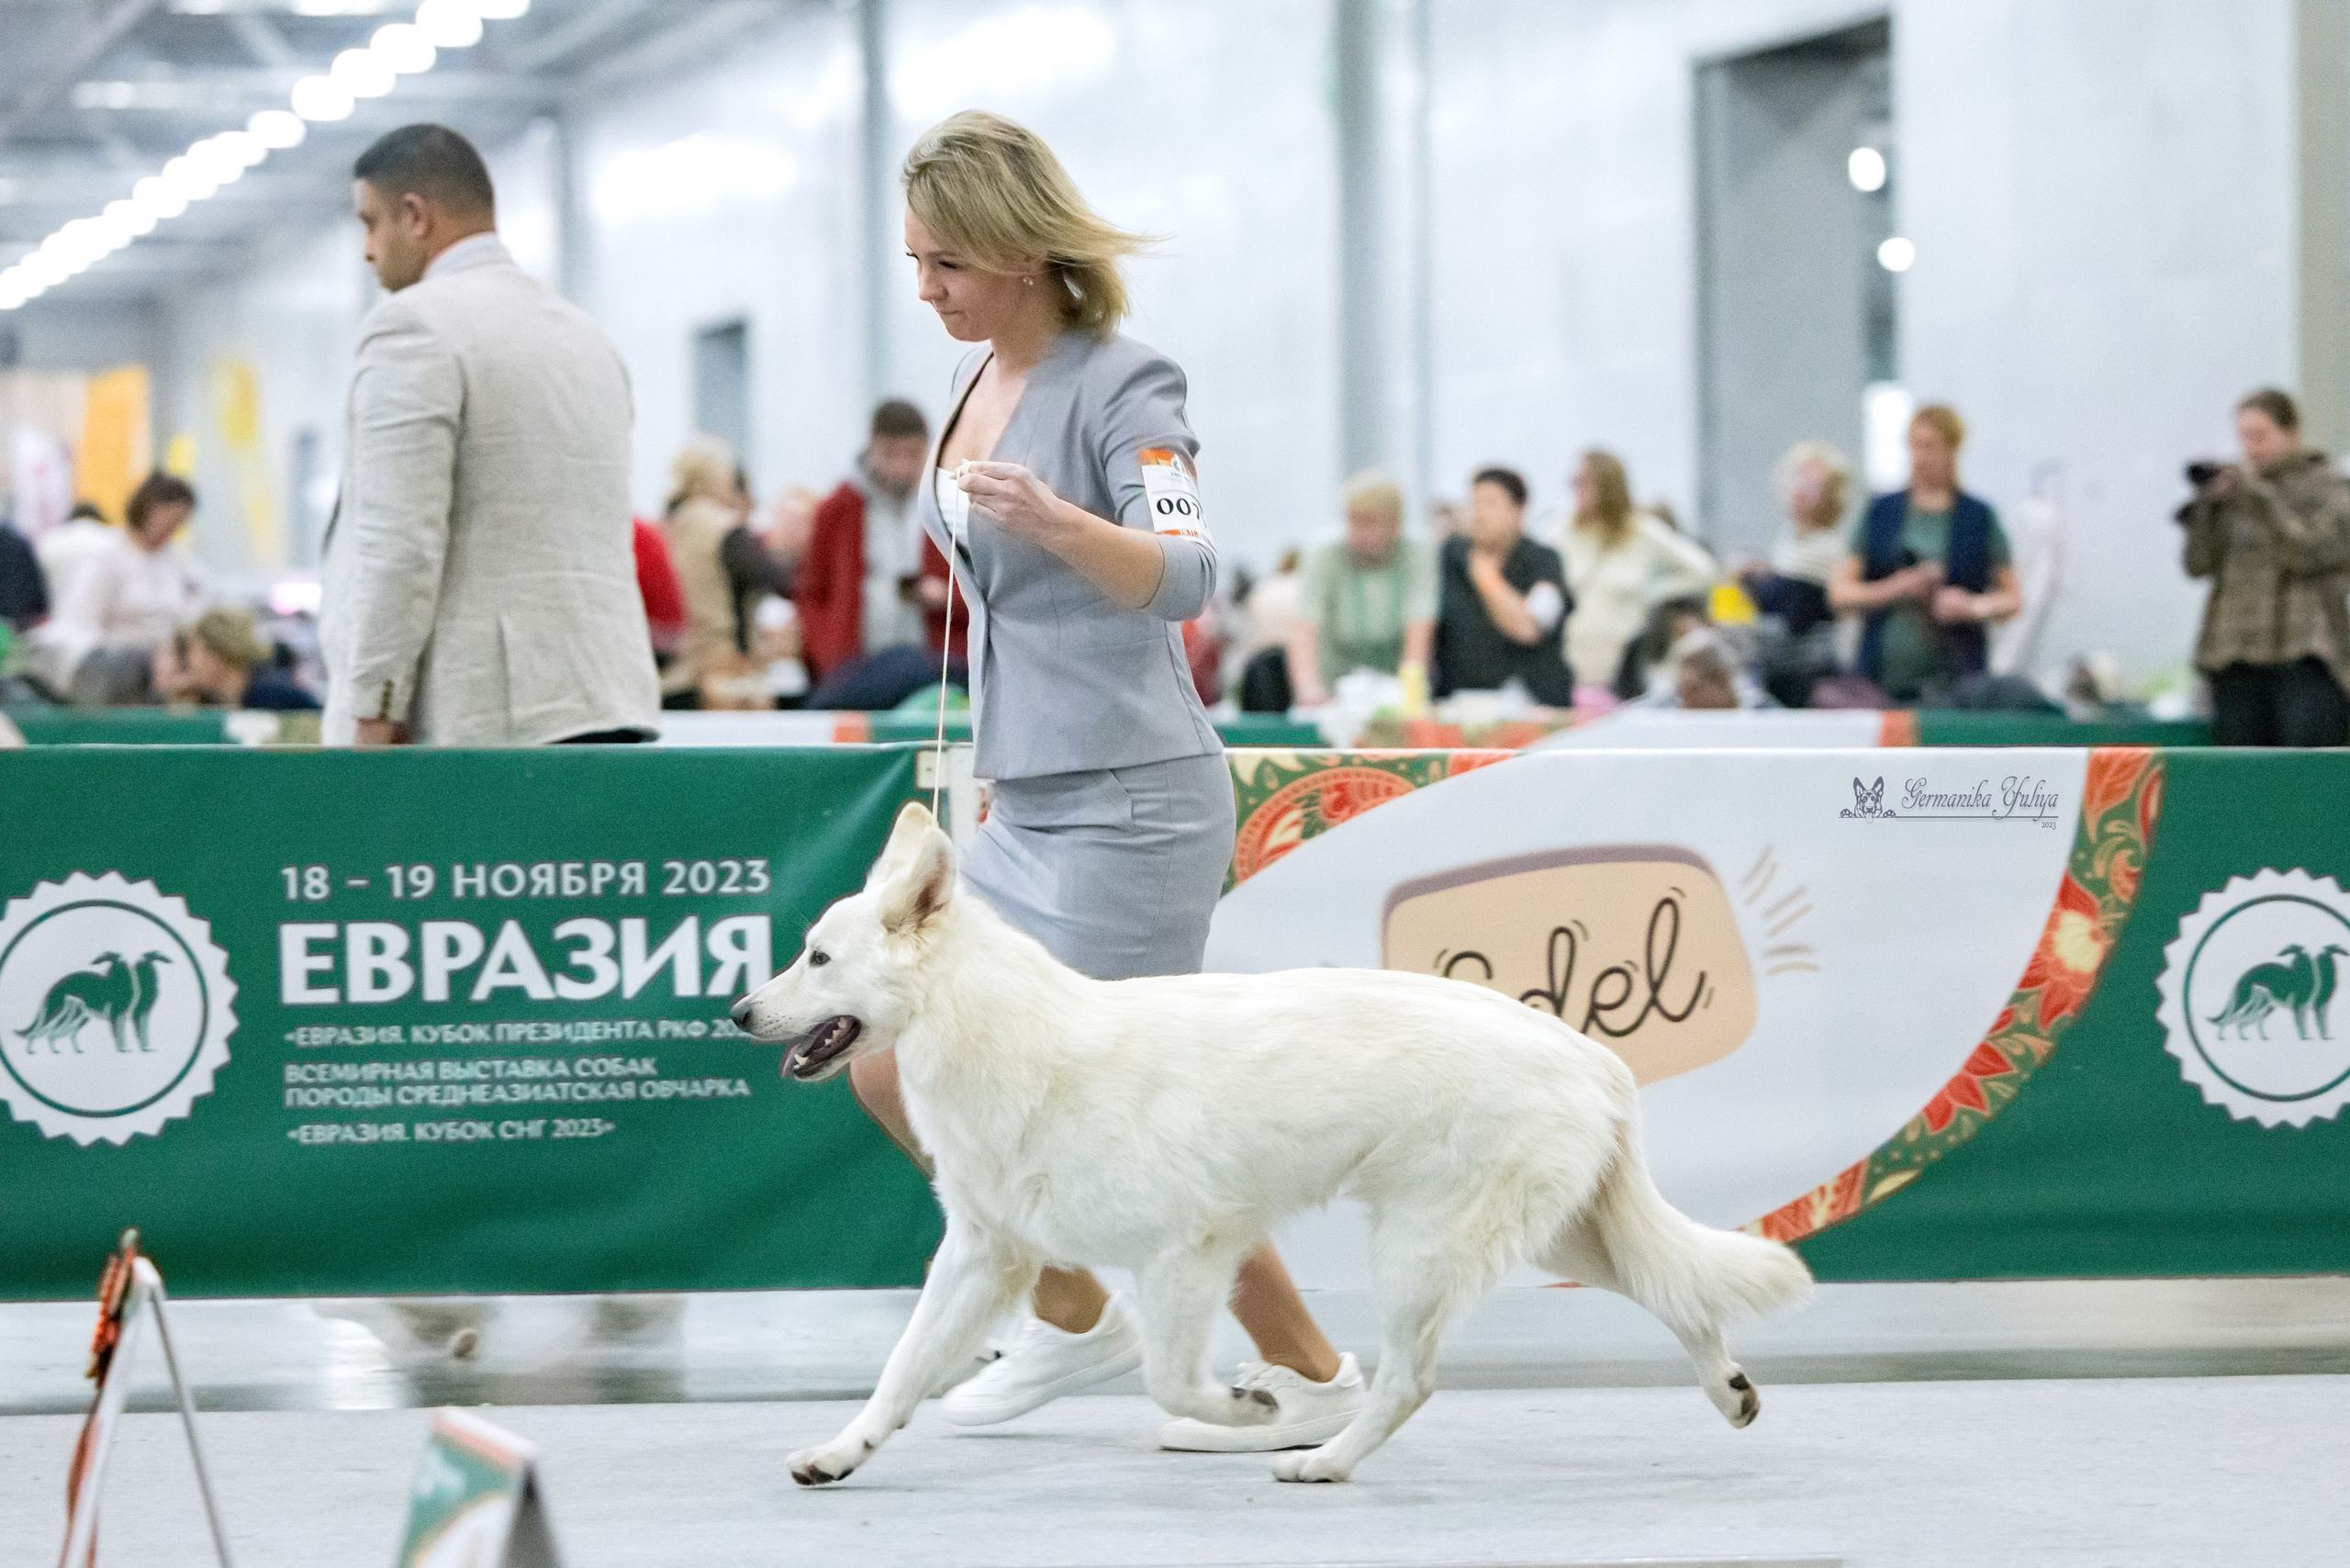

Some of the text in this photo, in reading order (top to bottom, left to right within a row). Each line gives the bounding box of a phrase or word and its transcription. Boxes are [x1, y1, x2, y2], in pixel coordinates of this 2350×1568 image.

[281, 866, 330, 901] 18
[387, 865, 436, 898] 19
[453, 862, 646, 898] НОЯБРЯ
[662, 860, 770, 894] 2023
[280, 916, 771, 1003] ЕВРАЗИЯ
[1444, 897, 1707, 1037] del
[411, 1025, 494, 1045] КУБОК
[497, 1019, 654, 1045] ПРЕЗИДЕНТА
[659, 1017, 708, 1041] РКФ
[285, 1056, 656, 1083] ВСЕМИРНАЯ ВЫСТАВКА СОБАК
[285, 1079, 749, 1107] ПОРОДЫ СРЕДНЕАЗИАТСКАЯ ОВЧАРКА
[414, 1121, 495, 1142] КУБОК
[498, 1118, 546, 1138] СНГ
